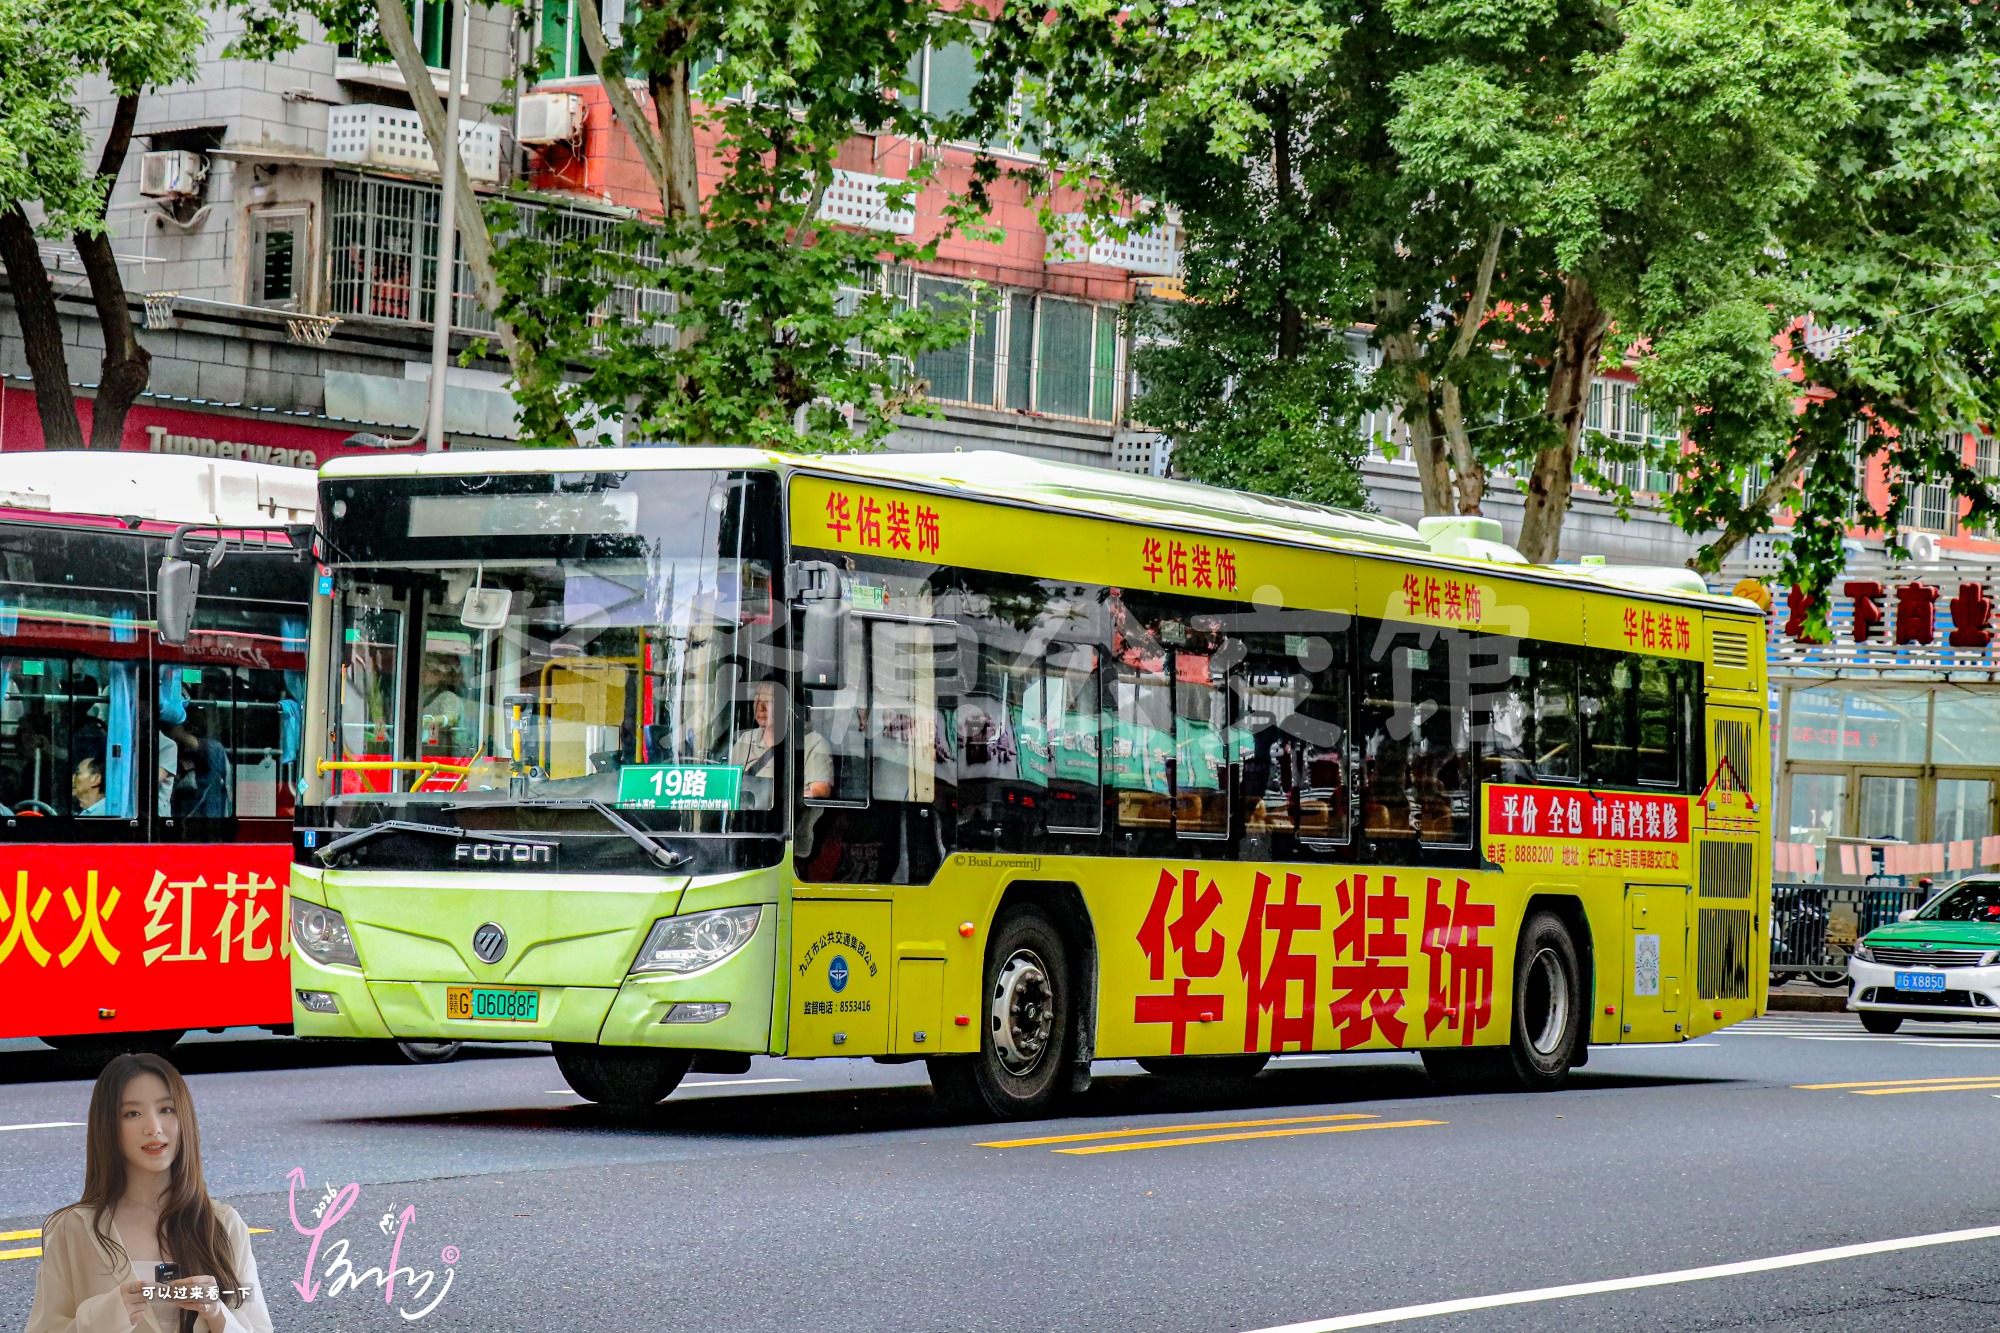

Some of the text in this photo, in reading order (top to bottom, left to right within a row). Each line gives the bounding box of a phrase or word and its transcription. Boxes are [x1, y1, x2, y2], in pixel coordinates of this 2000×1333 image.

[145, 425, 317, 468] Tupperware
[826, 490, 940, 555] 华佑装饰
[1142, 537, 1237, 593] 华佑装饰
[1403, 573, 1482, 624] 华佑装饰
[1623, 607, 1690, 653] 华佑装饰
[649, 769, 708, 797] 19路
[1502, 793, 1679, 839] 平价 全包 中高档装修
[455, 843, 550, 862] FOTON
[142, 869, 291, 967] 红花
[799, 931, 878, 978] 九江市公共交通集团公司
[1134, 867, 1496, 1055] 华佑装饰
[804, 1001, 871, 1015] 监督电话：8553416
